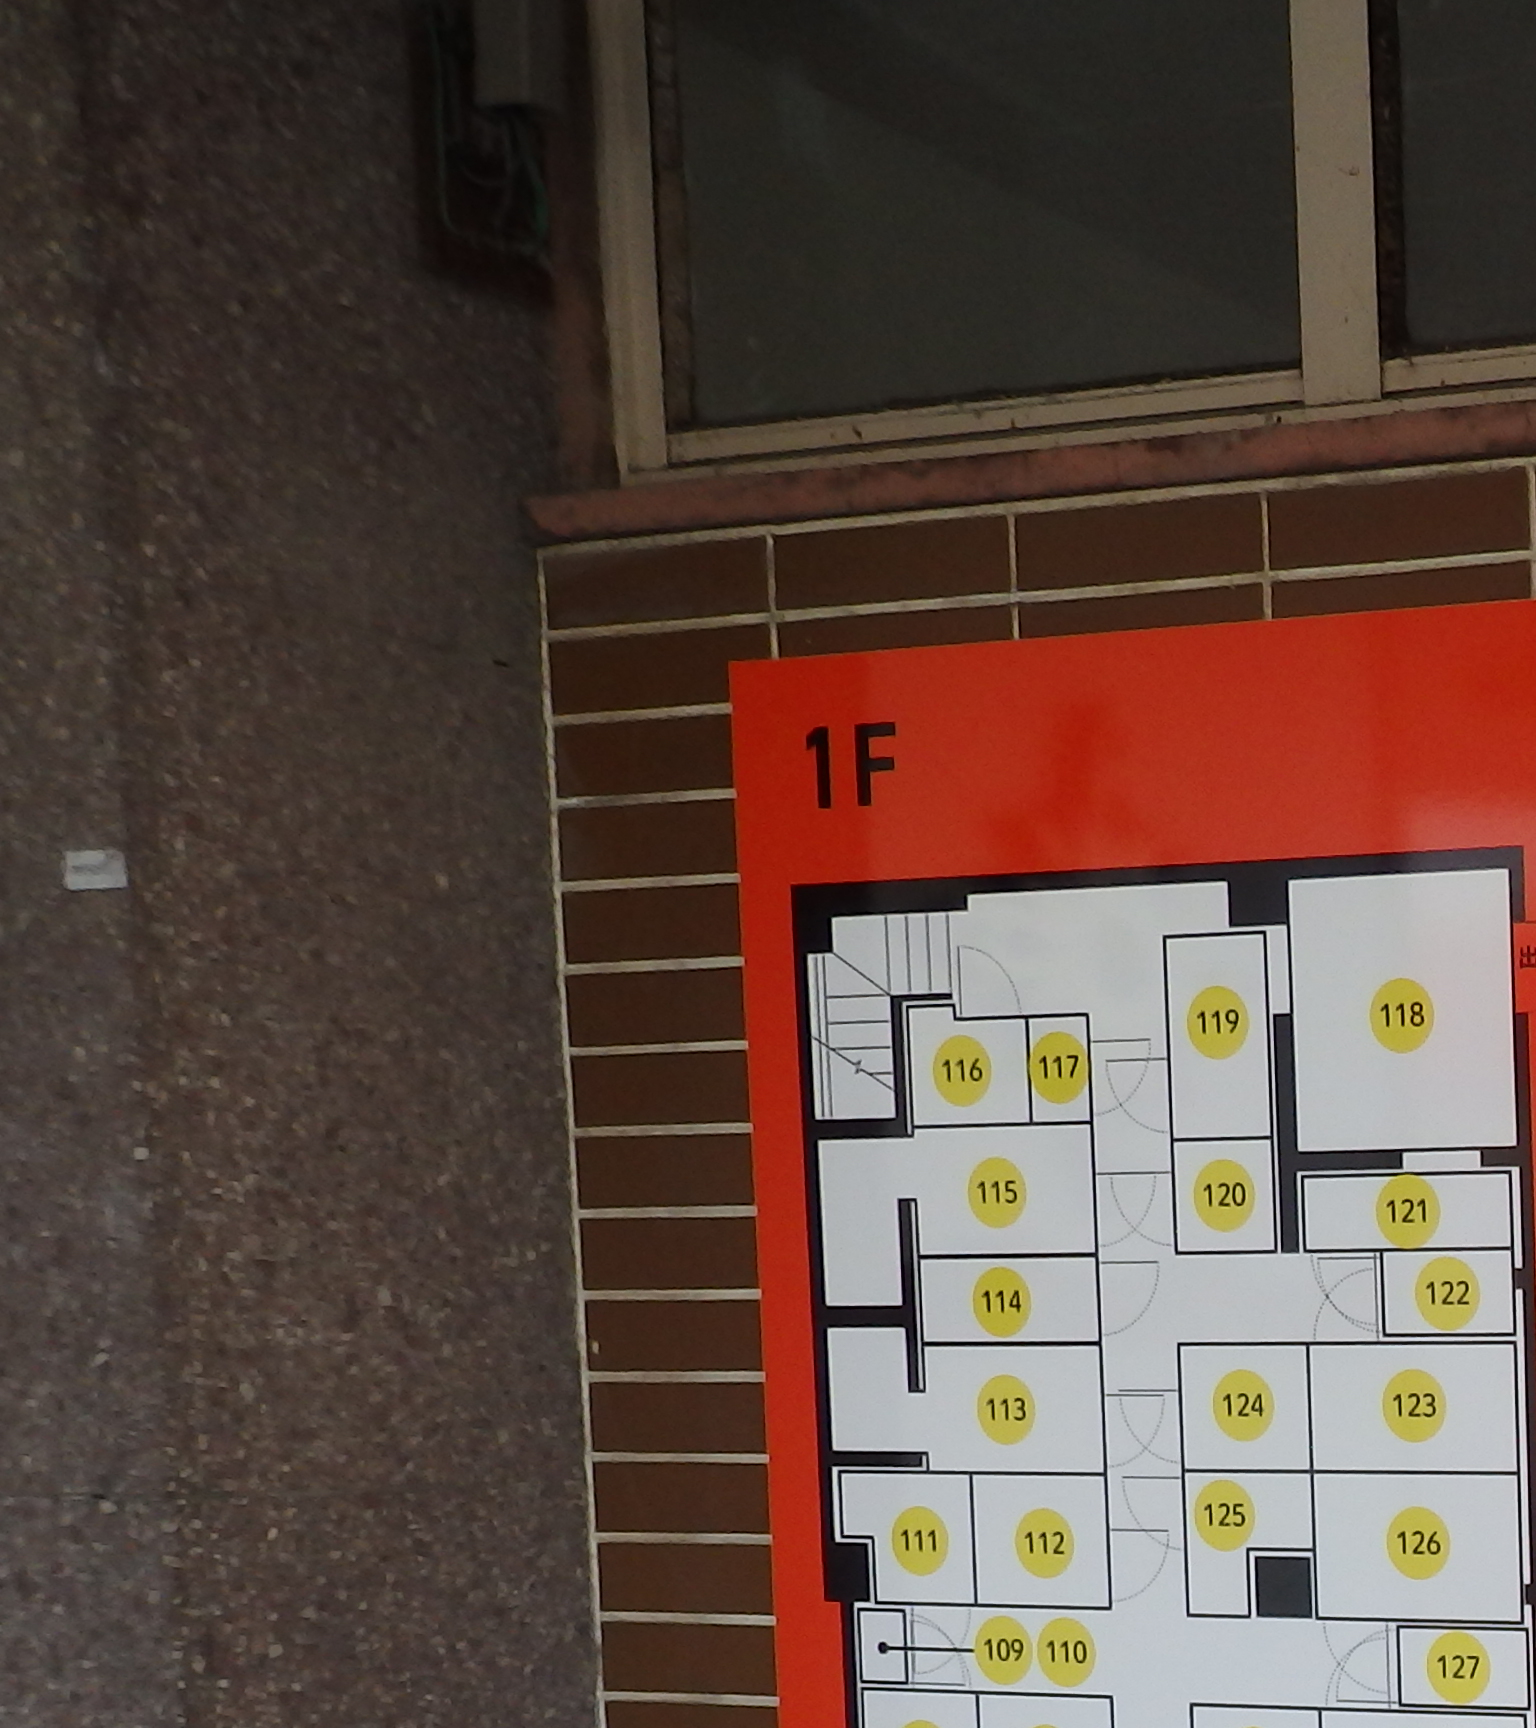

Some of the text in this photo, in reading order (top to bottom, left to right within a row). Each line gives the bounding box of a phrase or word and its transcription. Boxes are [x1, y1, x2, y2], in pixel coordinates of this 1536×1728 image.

[806, 722, 895, 809] 1F
[1197, 1009, 1239, 1034] 119
[1381, 1002, 1424, 1027] 118
[942, 1058, 982, 1082] 116
[1038, 1055, 1079, 1081] 117
[977, 1180, 1017, 1203] 115
[1204, 1182, 1245, 1206] 120
[1387, 1199, 1426, 1223] 121
[982, 1290, 1021, 1313] 114
[1426, 1281, 1469, 1305] 122
[987, 1398, 1026, 1421] 113
[1223, 1393, 1263, 1417] 124
[1393, 1393, 1436, 1417] 123
[1204, 1503, 1245, 1527] 125
[901, 1529, 936, 1551] 111
[1025, 1532, 1064, 1554] 112
[1397, 1531, 1440, 1555] 126
[984, 1639, 1023, 1661] 109
[1047, 1640, 1087, 1663] 110
[1437, 1655, 1479, 1679] 127
